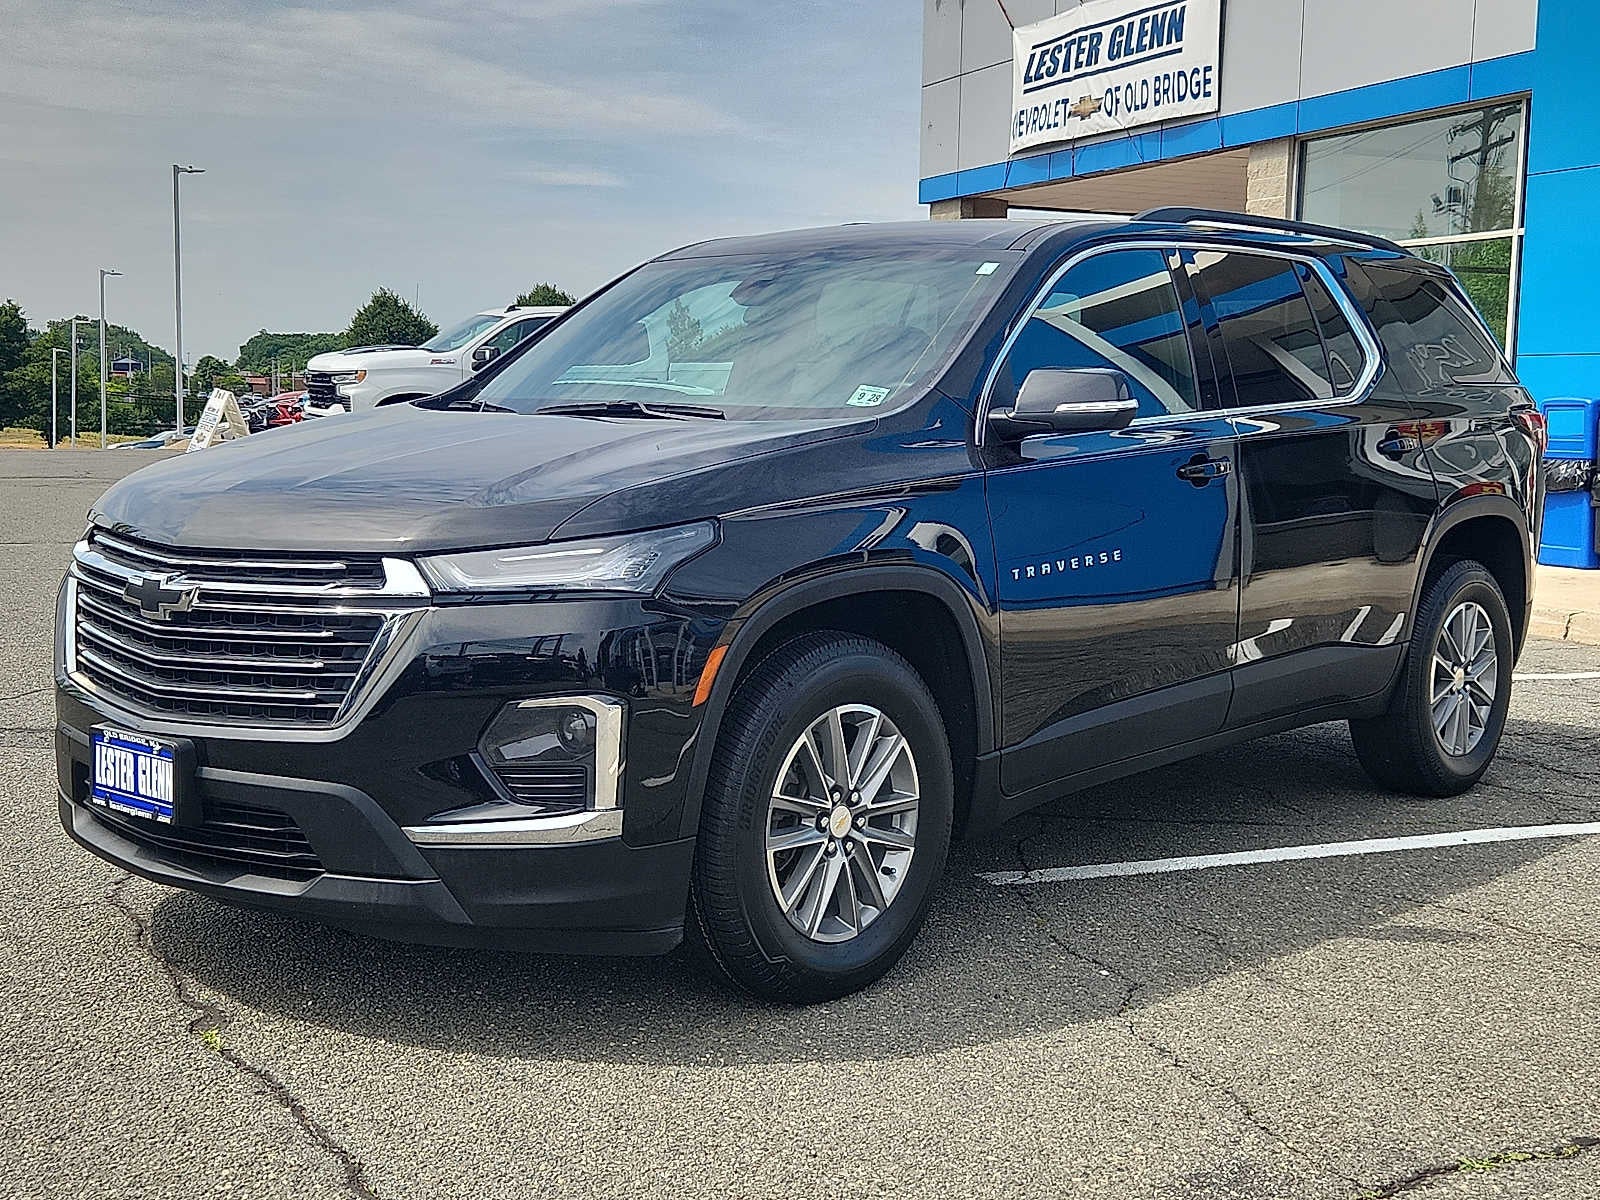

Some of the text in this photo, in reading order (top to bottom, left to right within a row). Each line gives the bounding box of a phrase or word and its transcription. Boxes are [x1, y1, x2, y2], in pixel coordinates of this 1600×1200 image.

[1023, 5, 1186, 84] LESTER GLENN
[1103, 85, 1121, 117] OF
[1124, 79, 1149, 111] OLD
[1153, 65, 1213, 107] BRIDGE
[857, 392, 866, 400] 9
[867, 393, 882, 403] 28
[1011, 549, 1122, 581] TRAVERSE
[95, 744, 174, 803] LESTER GLENN
